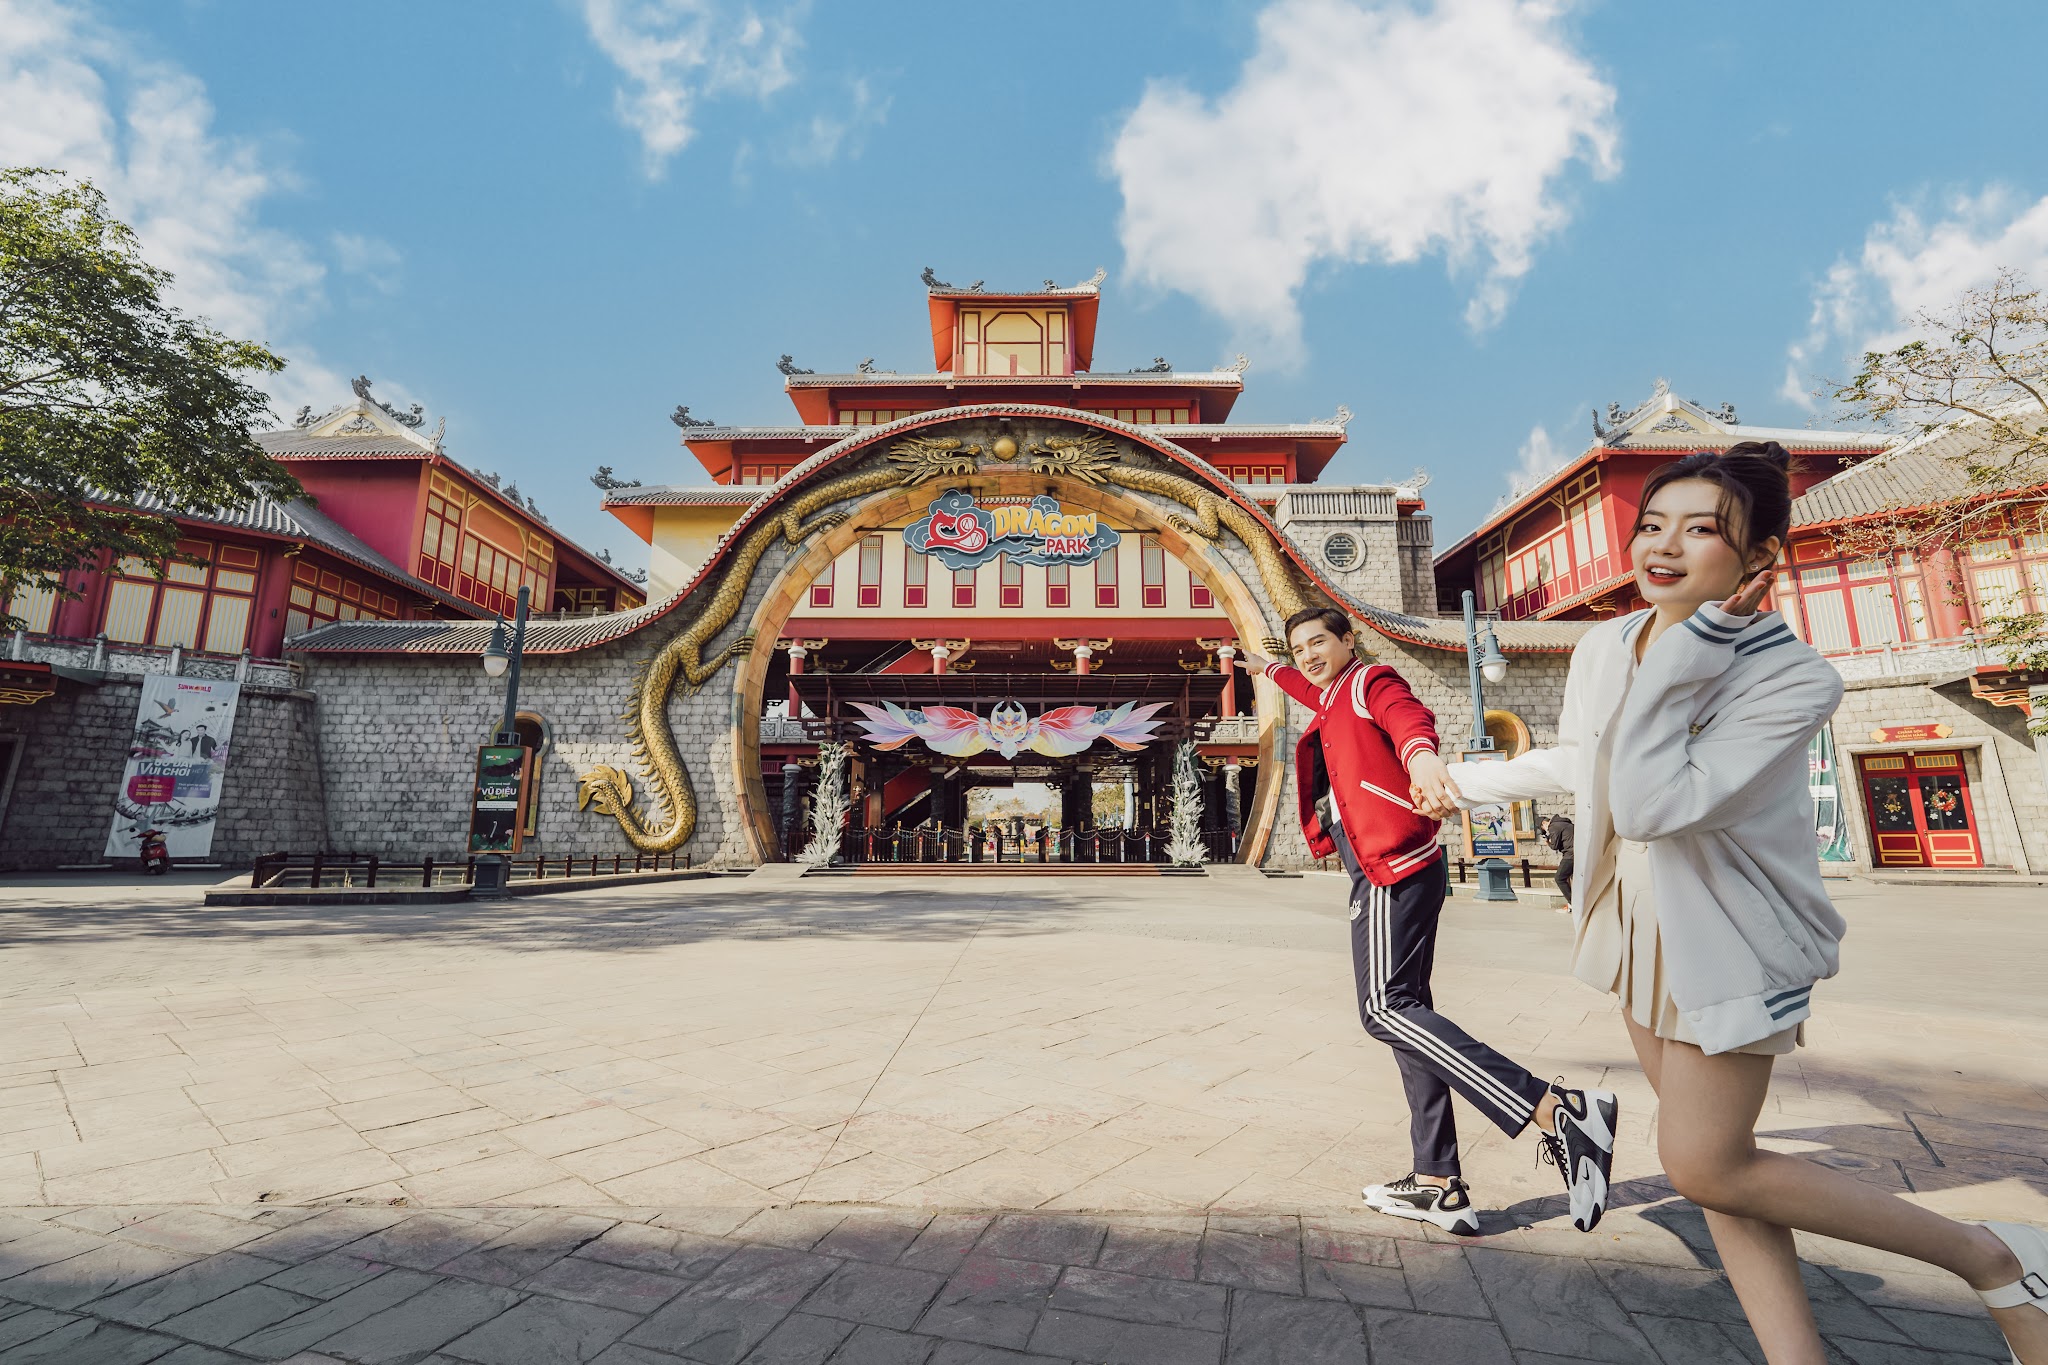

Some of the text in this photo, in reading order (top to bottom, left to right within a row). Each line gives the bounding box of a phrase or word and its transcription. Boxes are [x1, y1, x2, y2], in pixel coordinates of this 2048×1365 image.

[992, 506, 1097, 541] DRAGON
[1046, 538, 1091, 554] PARK
[481, 787, 494, 795] VŨ
